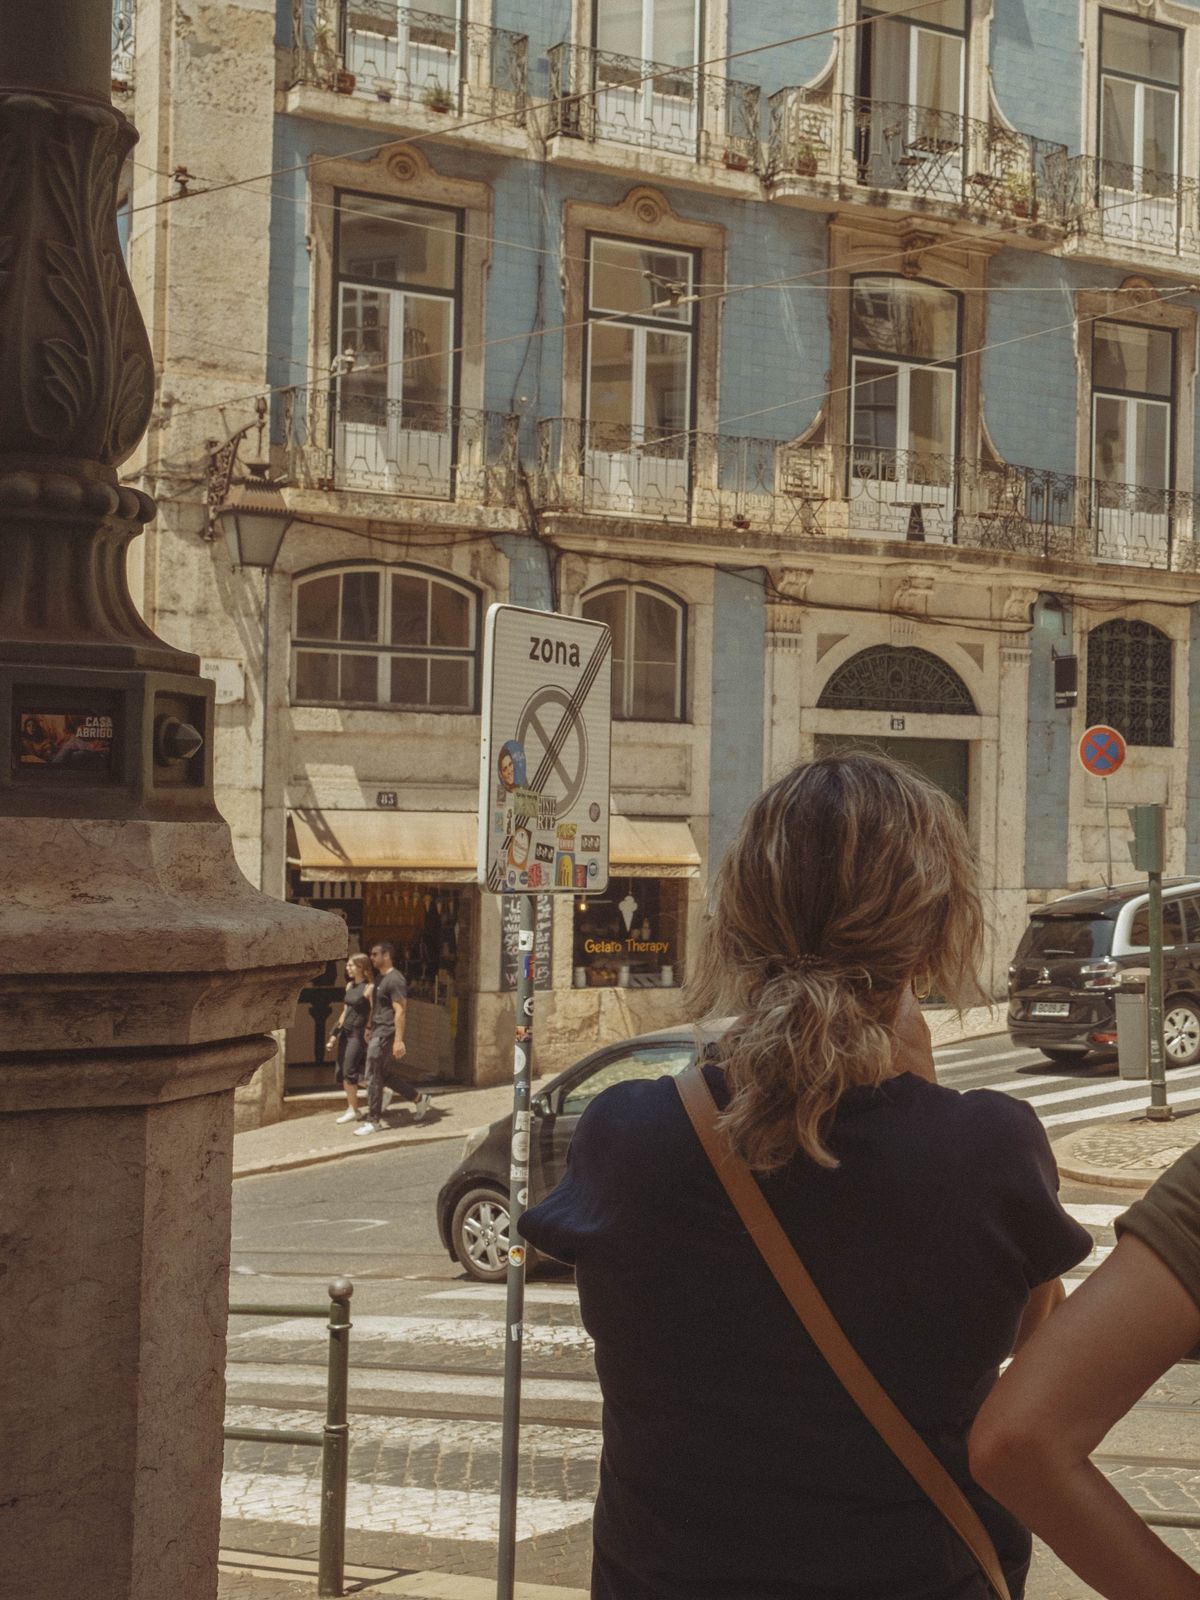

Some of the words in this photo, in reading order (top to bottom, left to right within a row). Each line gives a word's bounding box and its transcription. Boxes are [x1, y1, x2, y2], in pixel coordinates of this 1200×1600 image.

[529, 636, 580, 667] zona
[86, 716, 112, 727] CASA
[76, 727, 113, 738] ABRIGO
[585, 938, 622, 953] Gelato
[625, 938, 669, 953] Therapy
